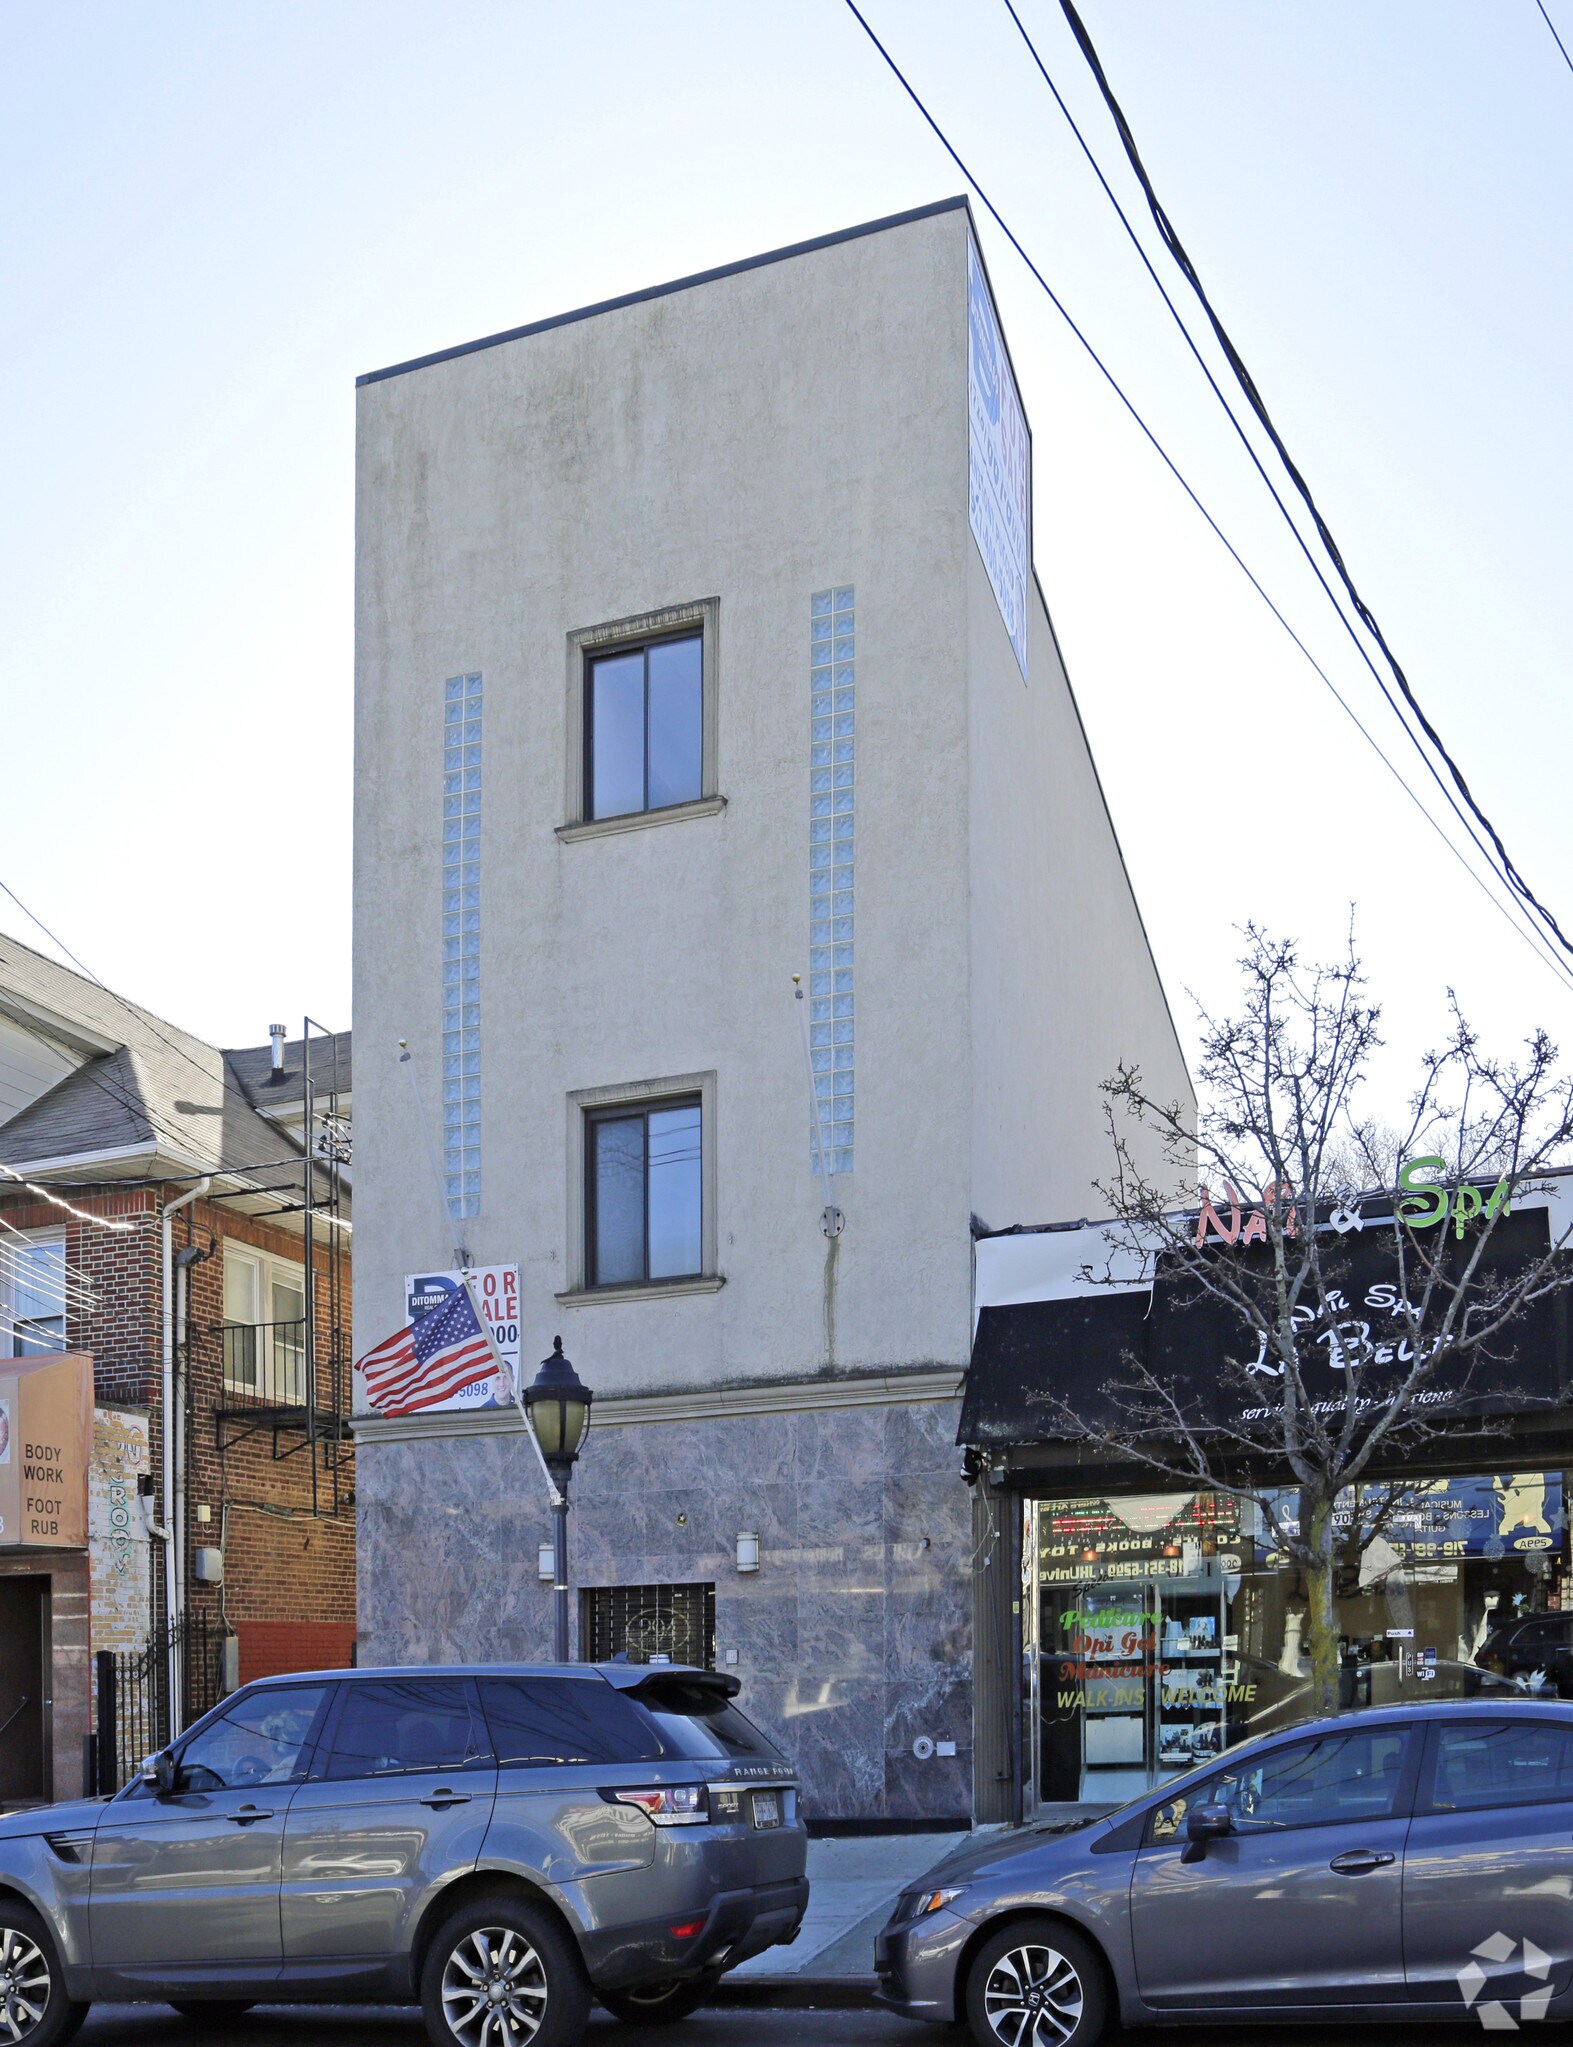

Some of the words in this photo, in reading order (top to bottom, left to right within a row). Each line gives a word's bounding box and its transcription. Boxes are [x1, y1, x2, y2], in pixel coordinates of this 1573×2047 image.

[1330, 1181, 1365, 1234] &
[471, 1271, 517, 1297] OR
[482, 1296, 518, 1322] ALE
[25, 1443, 62, 1462] BODY
[23, 1465, 63, 1484] WORK
[26, 1498, 62, 1516] FOOT
[31, 1519, 59, 1536] RUB
[1059, 1606, 1165, 1630] Pedicure
[1073, 1633, 1115, 1661] Opi
[1058, 1660, 1172, 1682] Manicure
[1057, 1687, 1146, 1708] WALK-INS
[1161, 1684, 1258, 1706] WELCOME
[734, 1767, 770, 1776] RANGE
